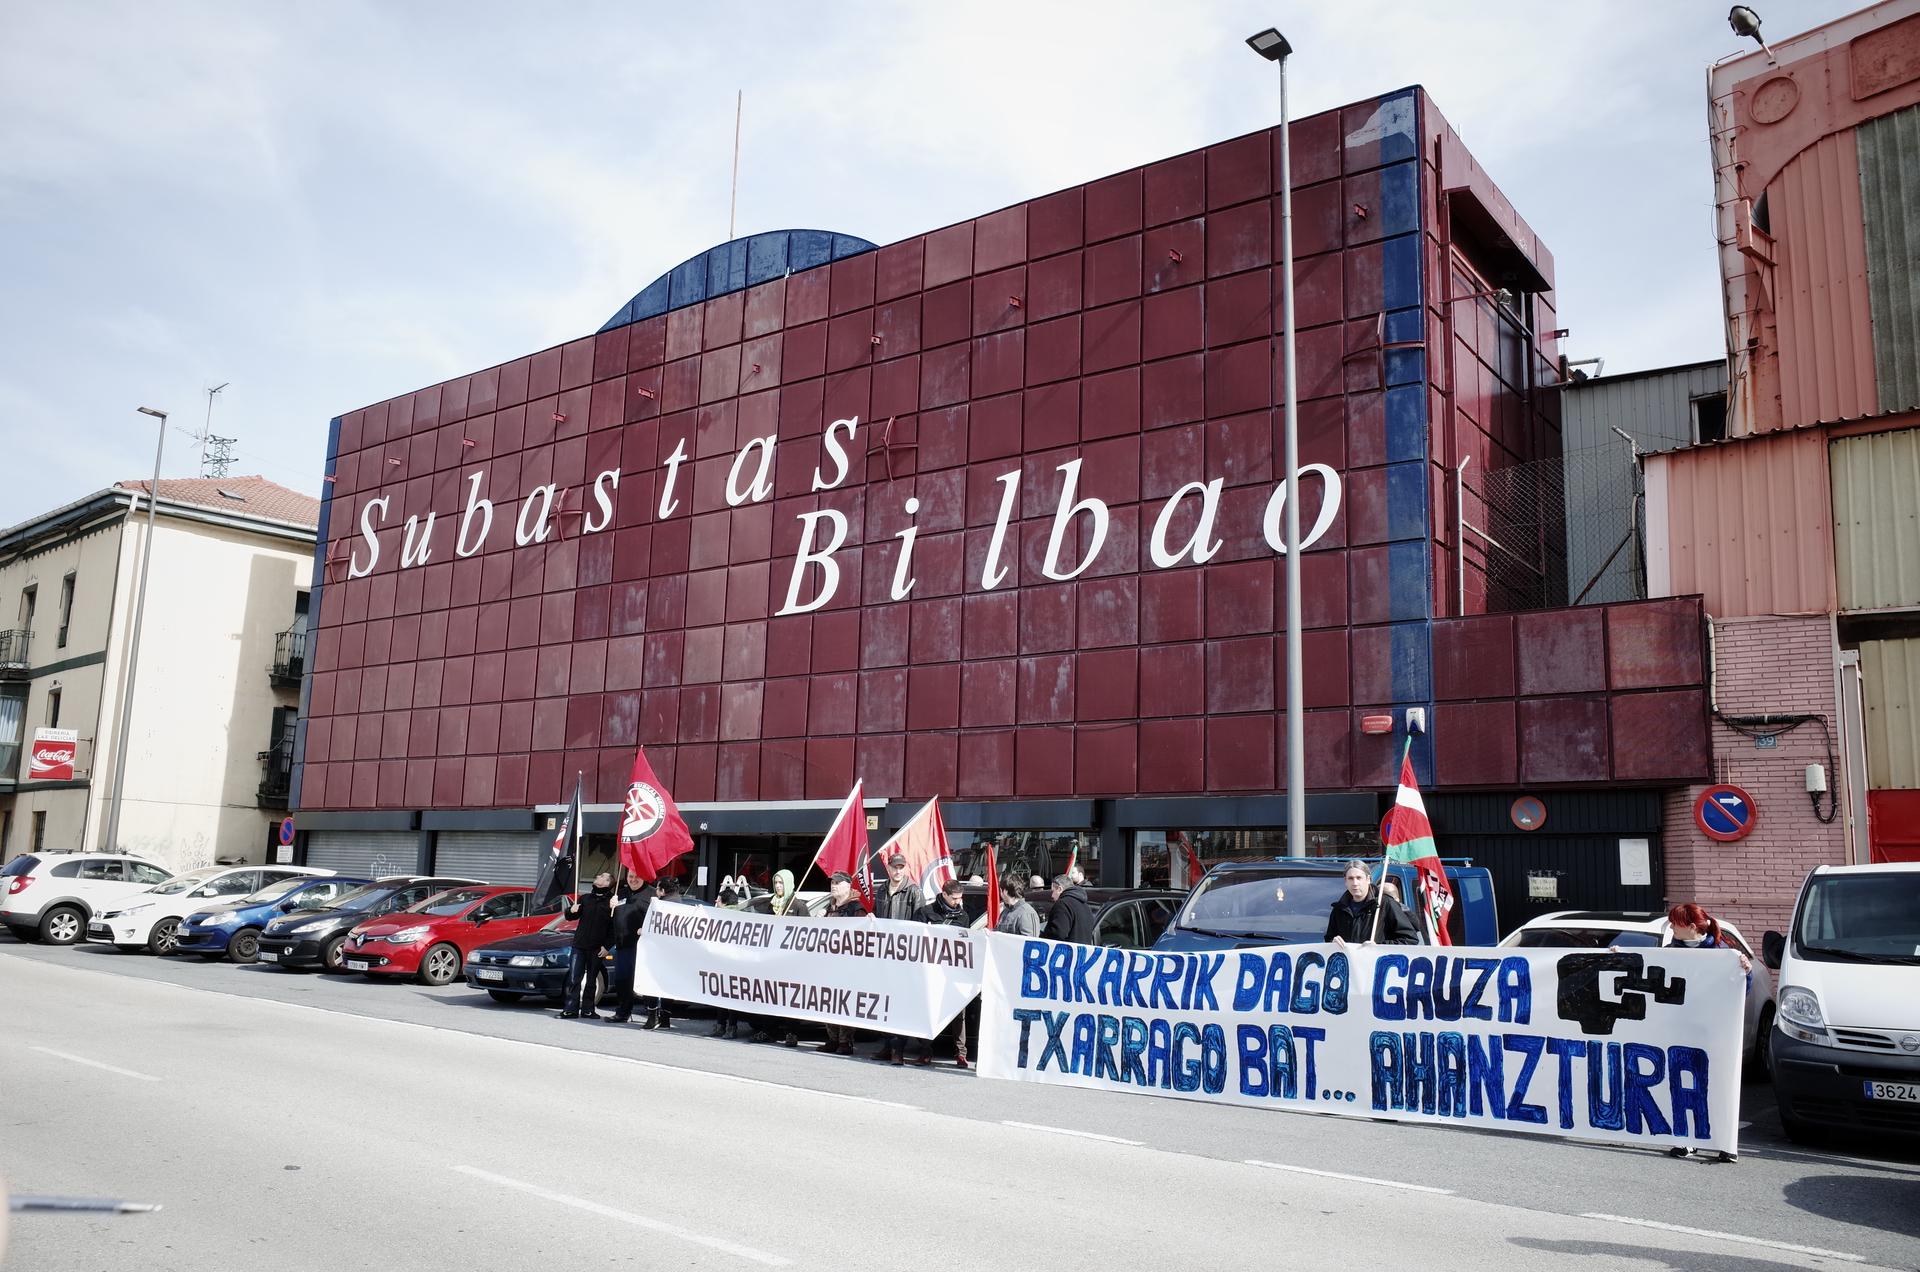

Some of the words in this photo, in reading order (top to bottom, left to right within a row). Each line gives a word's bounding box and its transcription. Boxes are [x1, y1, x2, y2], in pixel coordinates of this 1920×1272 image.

[347, 416, 859, 580] Subastas
[775, 458, 1342, 617] Bilbao
[700, 822, 708, 831] 40
[648, 910, 774, 948] FRANKISMOAREN
[780, 926, 974, 969] ZIGORGABETASUNARI
[699, 970, 852, 1017] TOLERANTZIARIK
[1020, 939, 1226, 1013] BAKARRIK
[1232, 951, 1350, 1016] DAGO
[1372, 953, 1532, 1026] GAUZA
[1012, 1008, 1228, 1095] TXARRAGO
[1368, 1030, 1712, 1140] AHANZTURA
[1875, 1084, 1918, 1101] 3624
